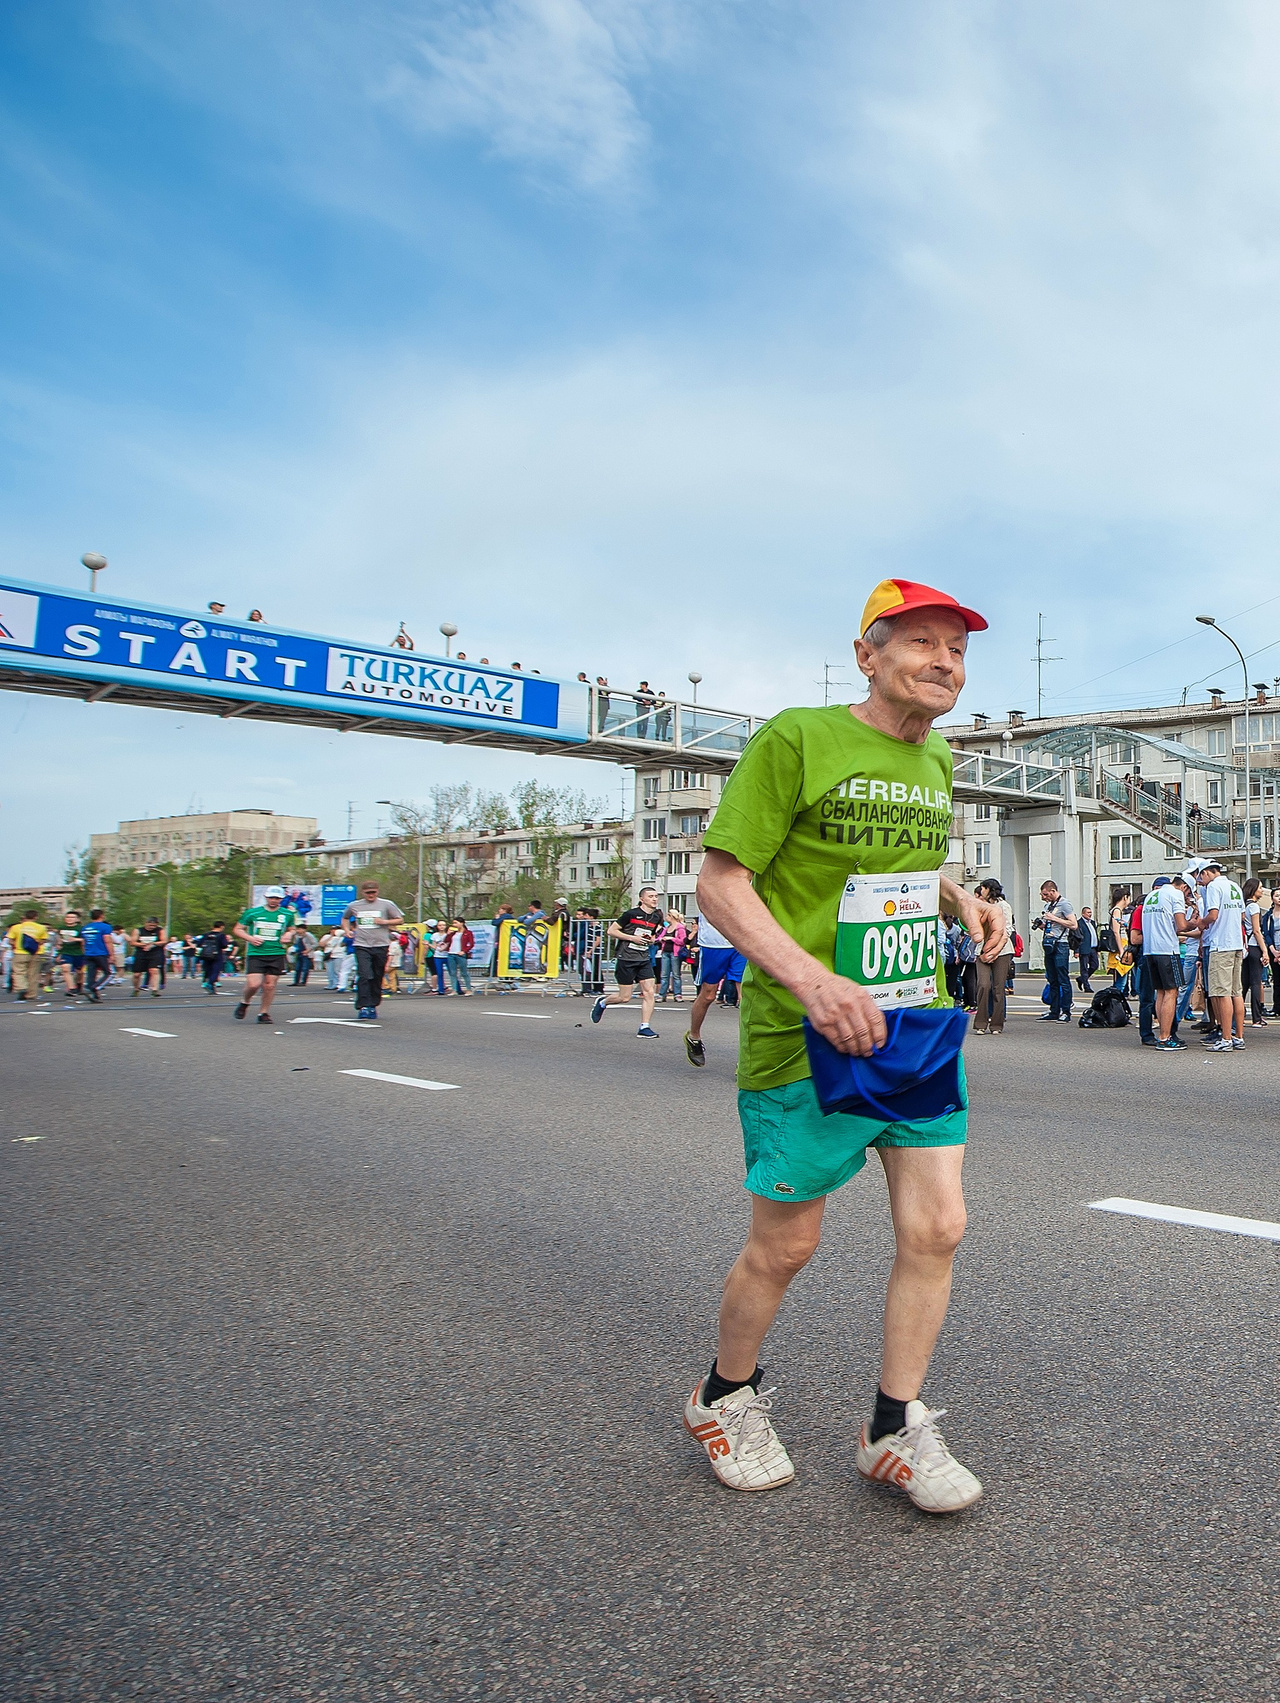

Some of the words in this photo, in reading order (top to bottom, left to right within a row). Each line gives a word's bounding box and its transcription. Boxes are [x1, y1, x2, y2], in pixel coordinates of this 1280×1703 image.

[62, 623, 307, 687] START
[340, 653, 514, 703] TURKUAZ
[341, 680, 514, 716] AUTOMOTIVE
[899, 902, 922, 911] HELIX
[861, 920, 937, 979] 09875
